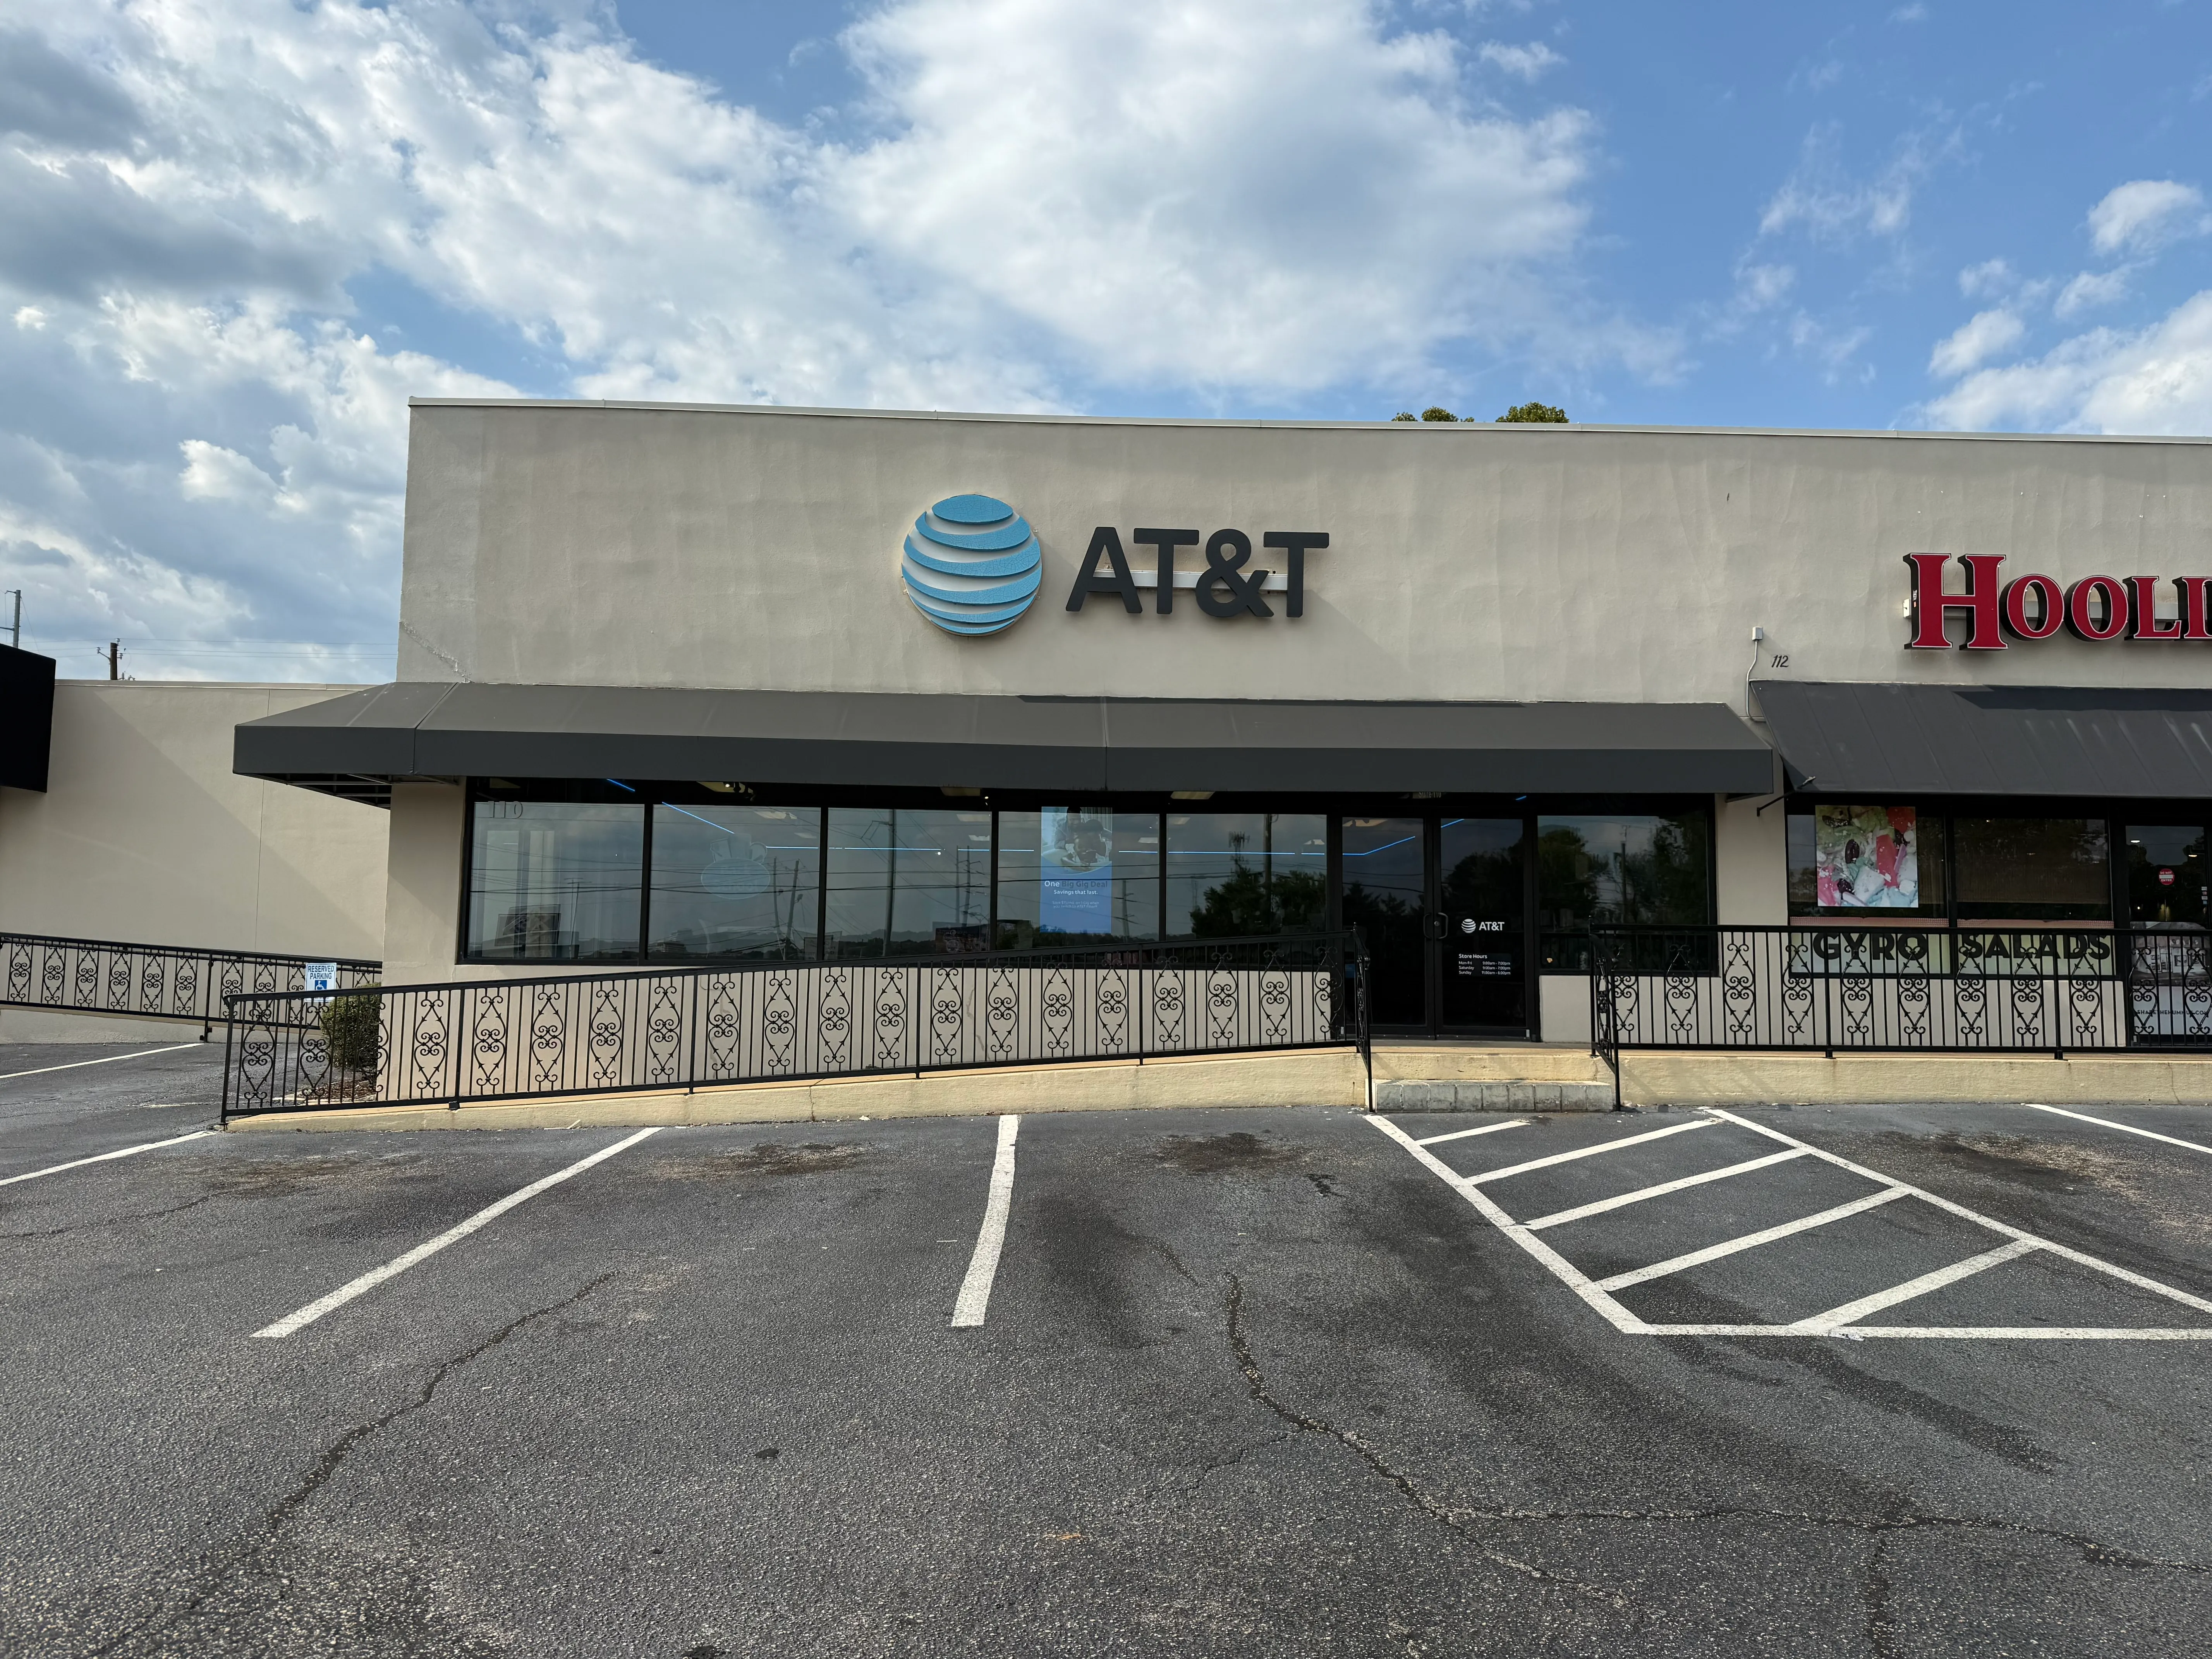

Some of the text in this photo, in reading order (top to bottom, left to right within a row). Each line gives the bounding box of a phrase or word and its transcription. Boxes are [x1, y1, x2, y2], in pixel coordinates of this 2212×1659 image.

[1065, 527, 1329, 618] AT&T
[1771, 655, 1789, 668] 112
[1479, 922, 1505, 931] AT&T
[1813, 932, 2110, 960] GYRO SALADS
